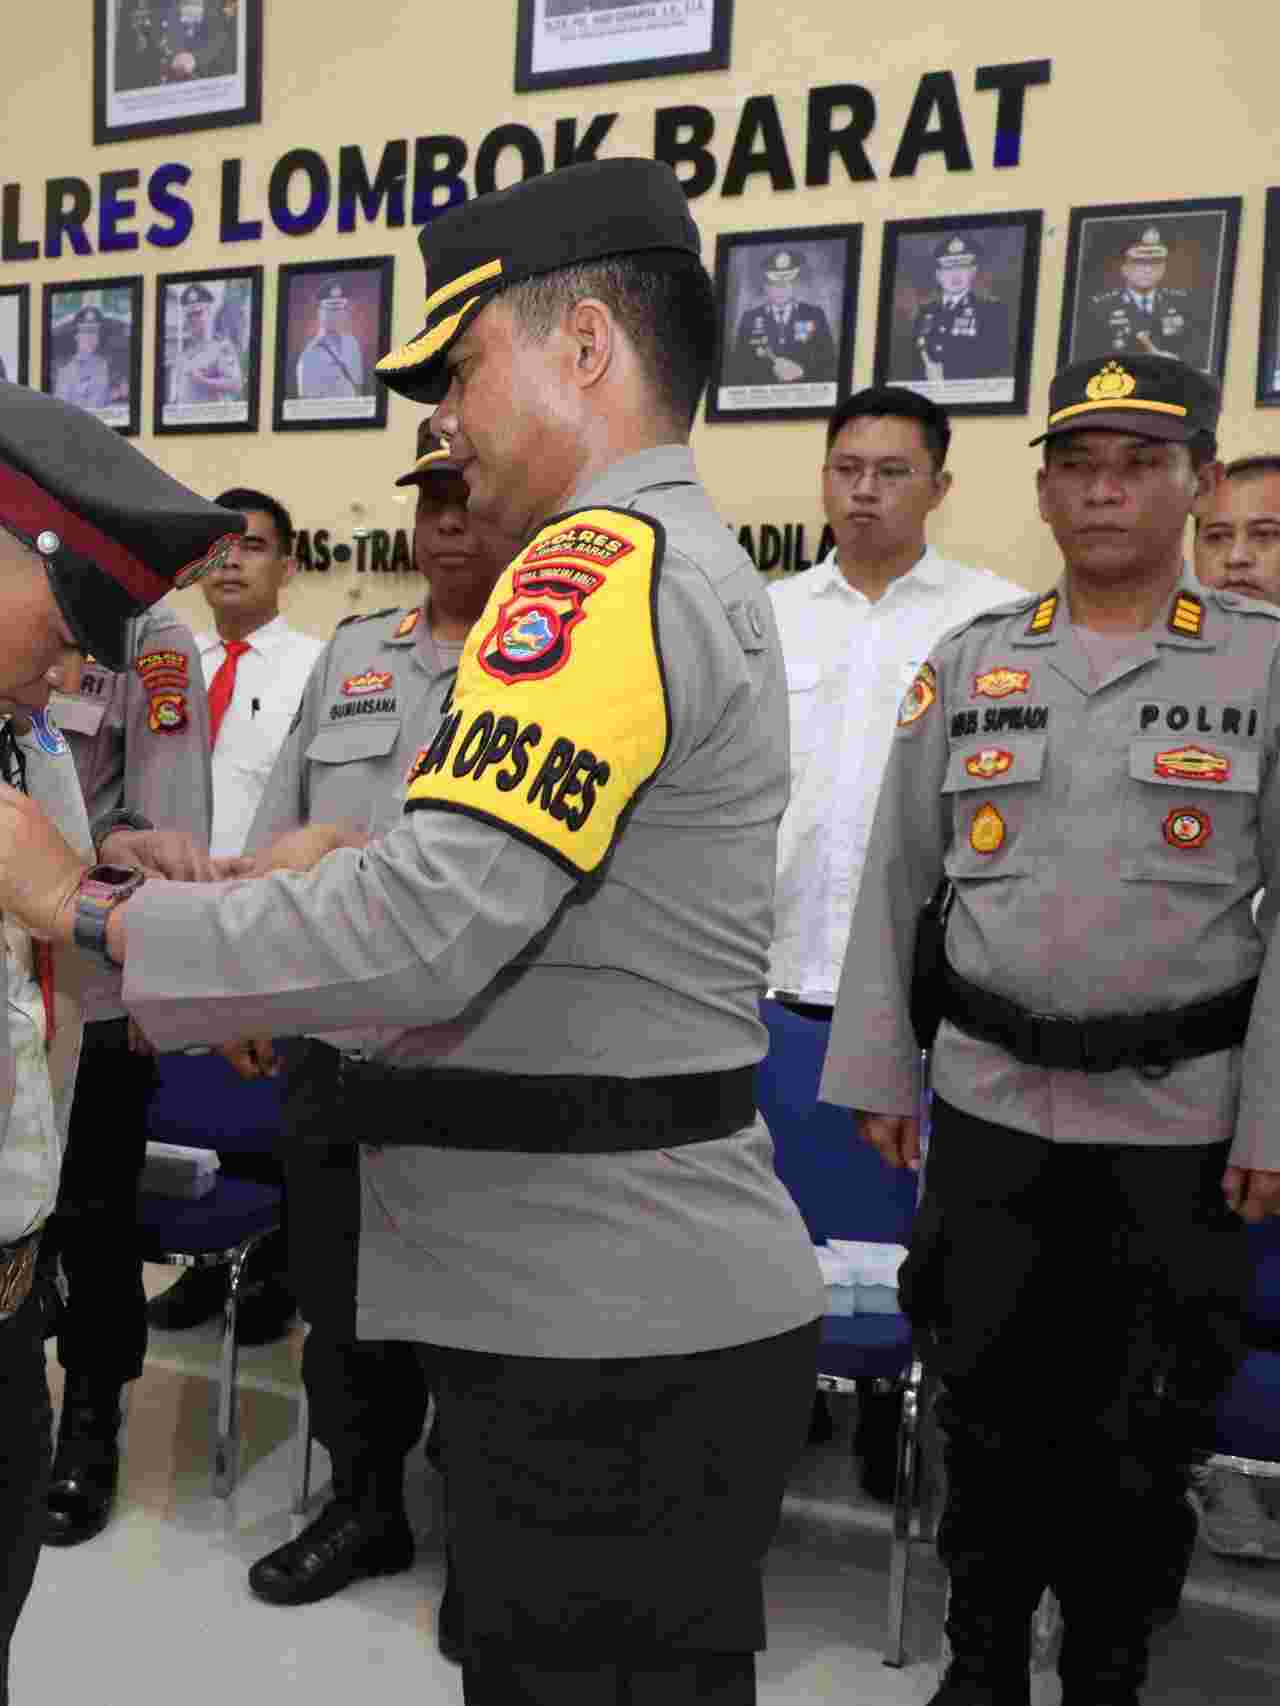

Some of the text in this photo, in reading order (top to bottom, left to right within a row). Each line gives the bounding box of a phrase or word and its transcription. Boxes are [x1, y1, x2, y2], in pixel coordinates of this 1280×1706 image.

[654, 58, 1053, 200] BARAT
[451, 709, 543, 793] OPS
[527, 735, 611, 832] RES
[1140, 704, 1257, 736] POLRI
